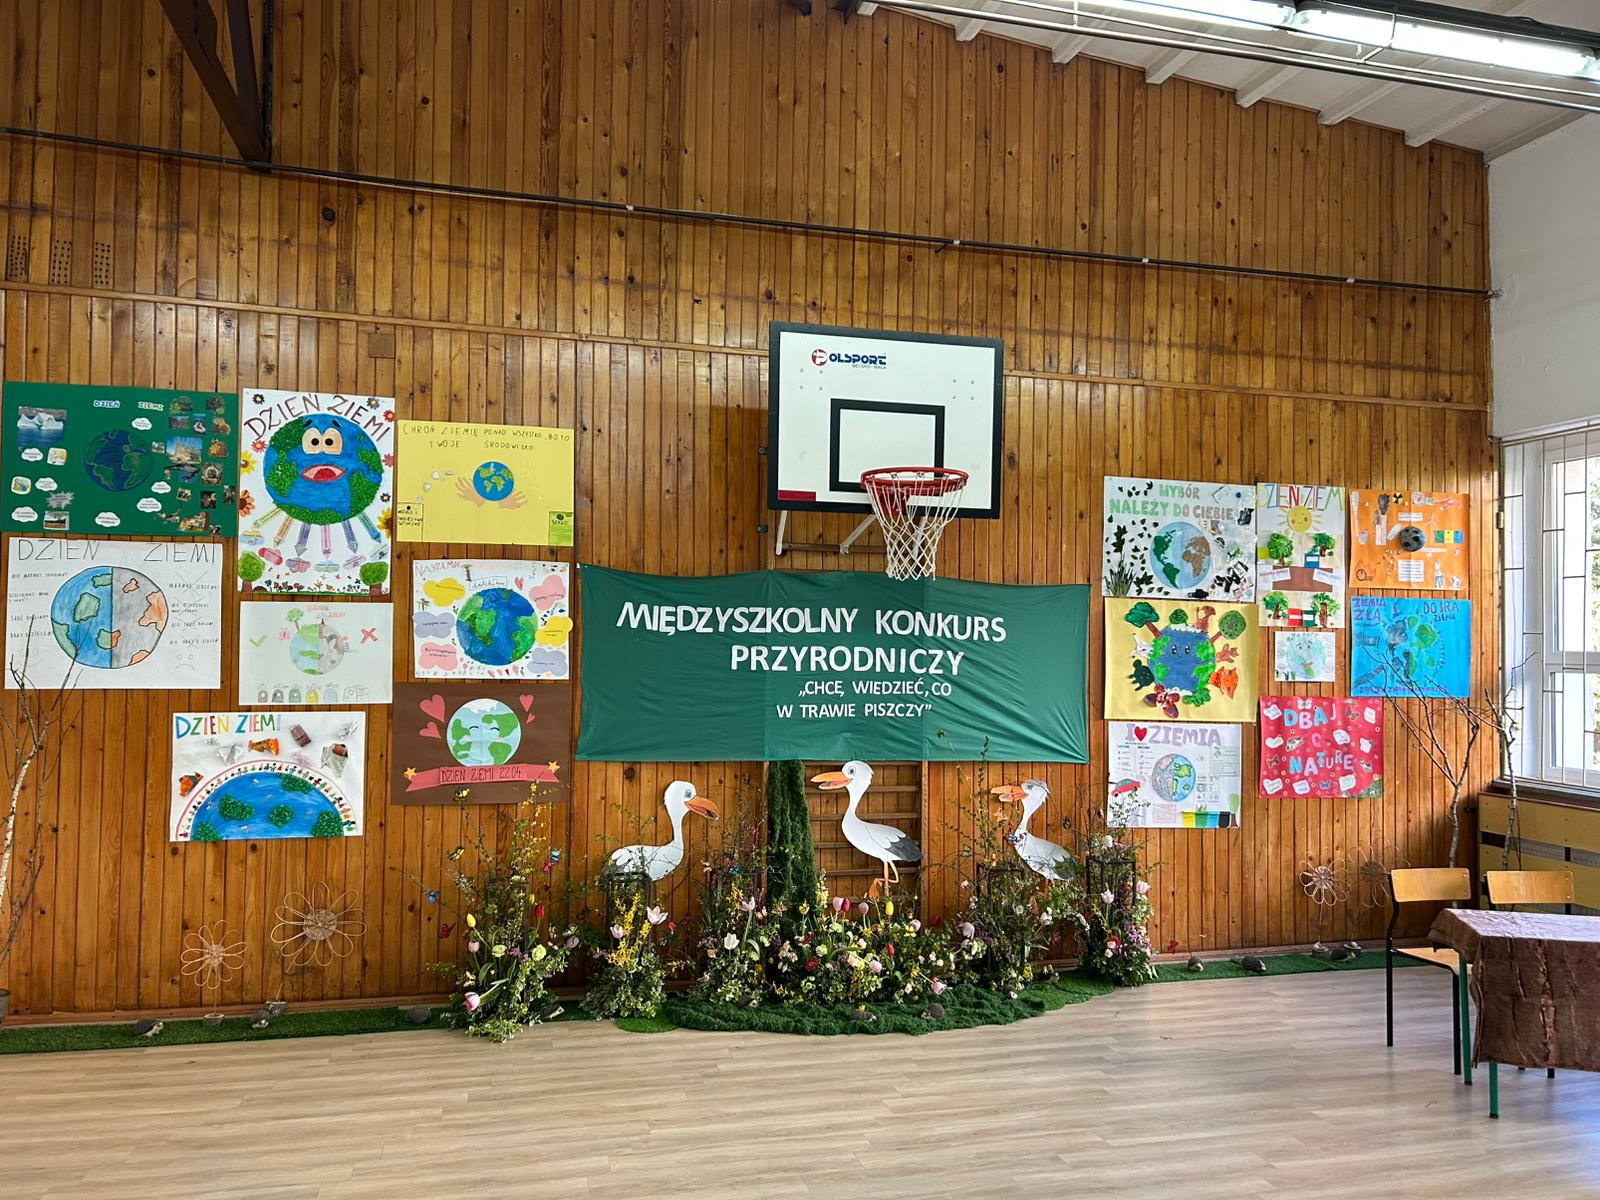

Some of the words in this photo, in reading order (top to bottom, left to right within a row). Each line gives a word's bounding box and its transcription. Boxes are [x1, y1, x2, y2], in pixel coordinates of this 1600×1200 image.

[137, 401, 164, 412] ZIEMI
[244, 393, 320, 440] DZIEŃ
[327, 395, 390, 442] ZIEMI
[429, 440, 461, 449] TWOJE
[1159, 483, 1200, 499] WYBÓR
[1109, 499, 1169, 516] NALEŻY
[1173, 504, 1190, 517] DO
[1193, 505, 1234, 521] CIEBIE
[18, 537, 102, 560] DZIEŃ
[143, 542, 215, 563] ZIEMI
[616, 601, 859, 637] MIĘDZYSZKOLNY
[875, 609, 1007, 643] KONKURS
[730, 645, 965, 676] PRZYRODNICZY
[852, 677, 929, 698] WIEDZIEĆ,
[931, 681, 952, 697] CO
[776, 704, 793, 719] W
[799, 704, 856, 719] TRAWIE
[1283, 703, 1337, 730] DBAJ
[235, 714, 281, 734] ZIEMI
[470, 767, 494, 782] ZIEMI
